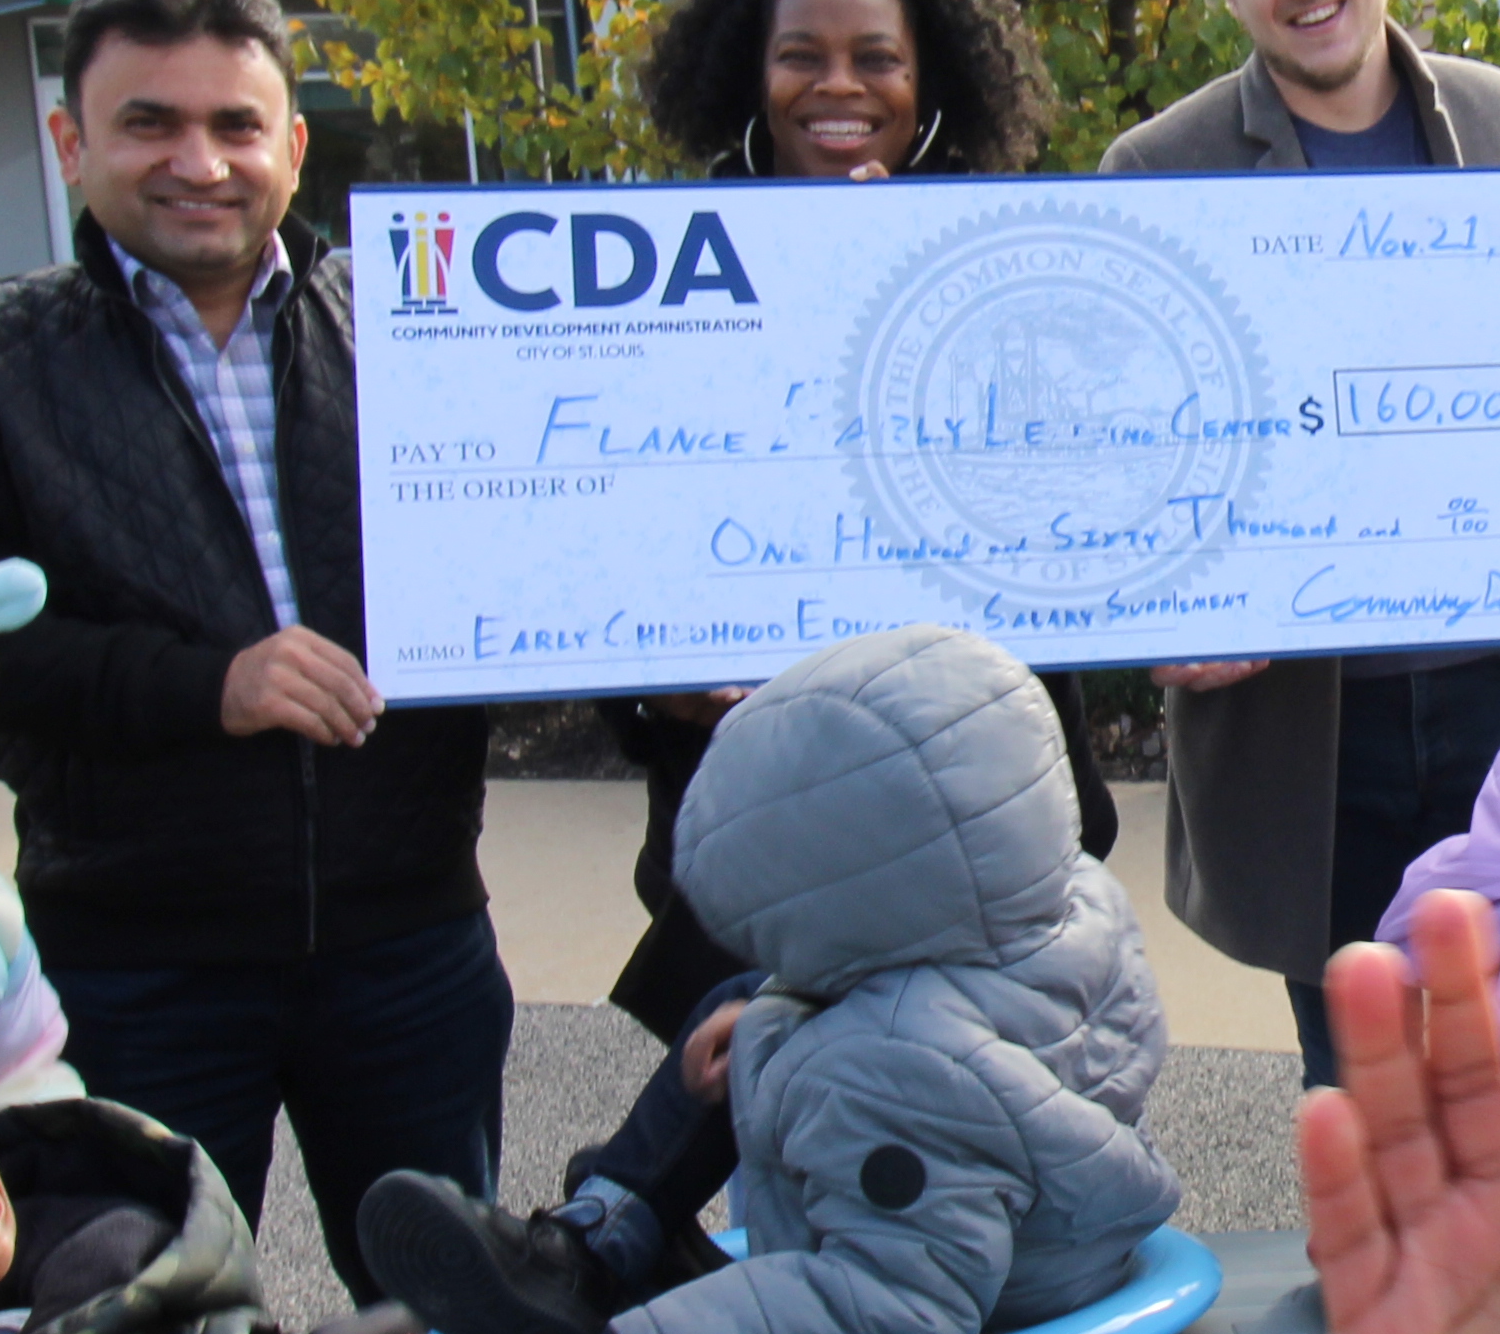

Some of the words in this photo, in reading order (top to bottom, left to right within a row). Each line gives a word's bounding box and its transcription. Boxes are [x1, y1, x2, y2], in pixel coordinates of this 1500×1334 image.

[1251, 235, 1324, 255] DATE
[471, 211, 760, 312] CDA
[920, 249, 1084, 328] COMMON
[1101, 258, 1190, 338] SEAL
[391, 325, 498, 341] COMMUNITY
[501, 321, 621, 338] DEVELOPMENT
[624, 317, 763, 334] ADMINISTRATION
[516, 345, 549, 361] CITY
[552, 345, 576, 360] OF
[578, 344, 596, 359] ST.
[599, 343, 645, 359] LOUIS
[1171, 391, 1292, 440] CENTER
[1299, 396, 1325, 436] $
[390, 443, 447, 464] PAY
[452, 440, 496, 461] TO
[390, 479, 456, 503] THE
[462, 476, 569, 499] ORDER
[575, 474, 616, 496] OF
[474, 614, 587, 661] EARLY
[397, 643, 465, 663] MEMO
